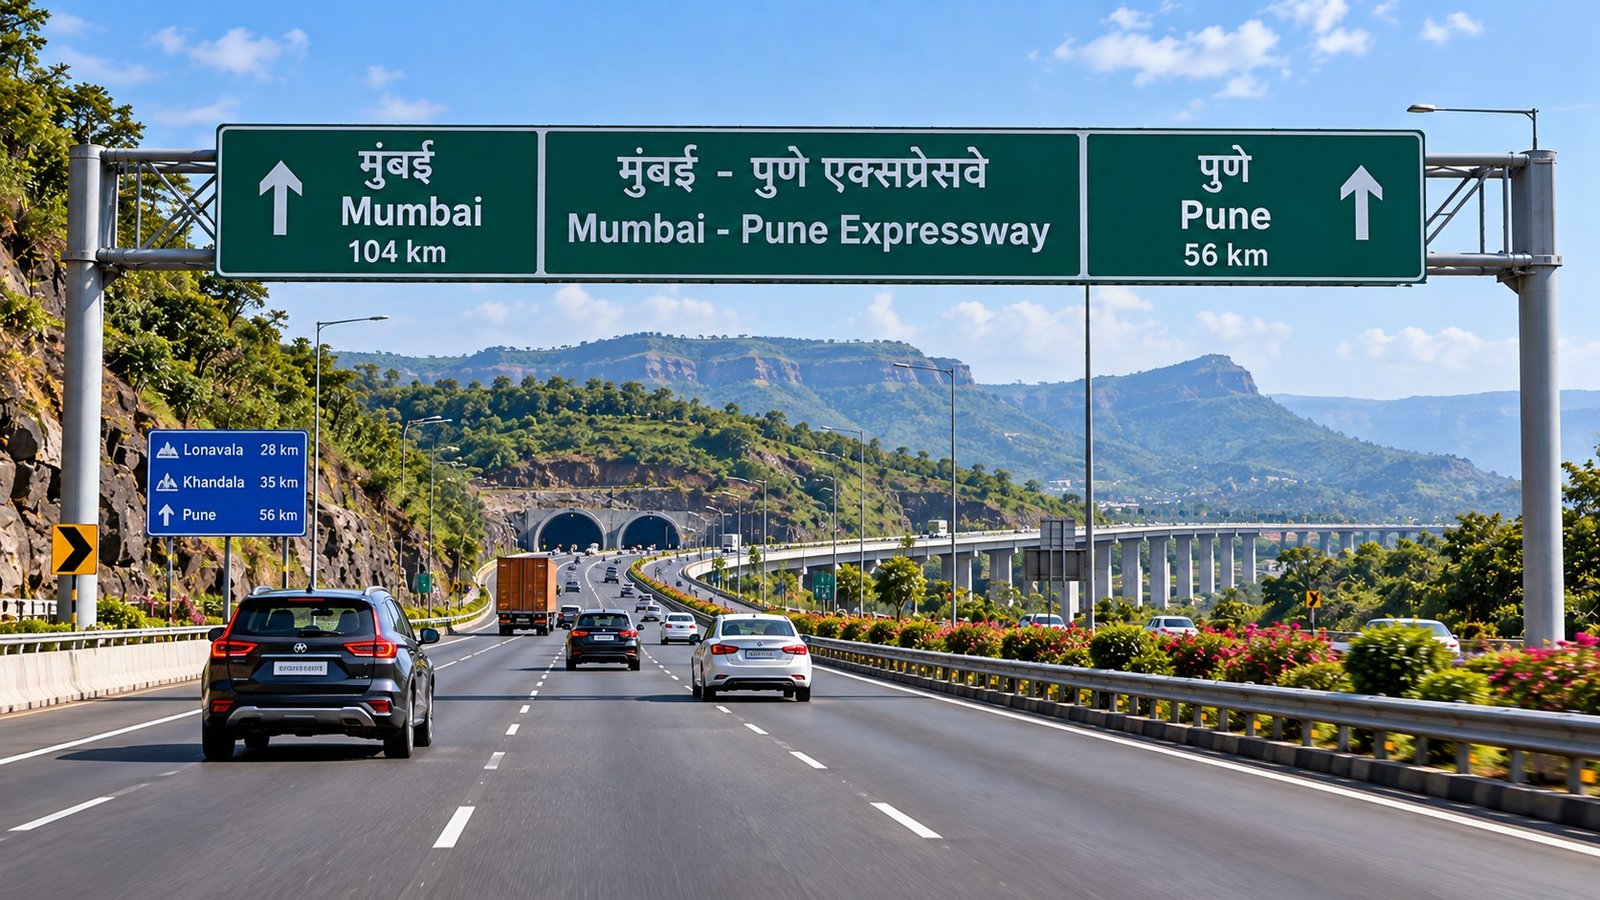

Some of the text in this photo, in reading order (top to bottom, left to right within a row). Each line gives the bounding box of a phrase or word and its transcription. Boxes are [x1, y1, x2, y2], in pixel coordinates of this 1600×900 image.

[358, 140, 435, 189] मुंबई
[617, 144, 698, 198] मुंबई
[751, 146, 809, 198] पुणे
[821, 146, 989, 193] एक्सप्रेसवे
[1198, 145, 1252, 193] पुणे
[341, 196, 482, 227] Mumbai
[1181, 199, 1271, 230] Pune
[568, 212, 705, 244] Mumbai
[742, 214, 828, 245] Pune
[840, 214, 1050, 254] Expressway
[348, 240, 446, 263] 104 km
[1184, 242, 1268, 267] 56 km
[184, 443, 299, 456] Lonavala 28 km
[183, 475, 298, 488] Khandala 35 km
[183, 509, 298, 521] Pune 56 km
